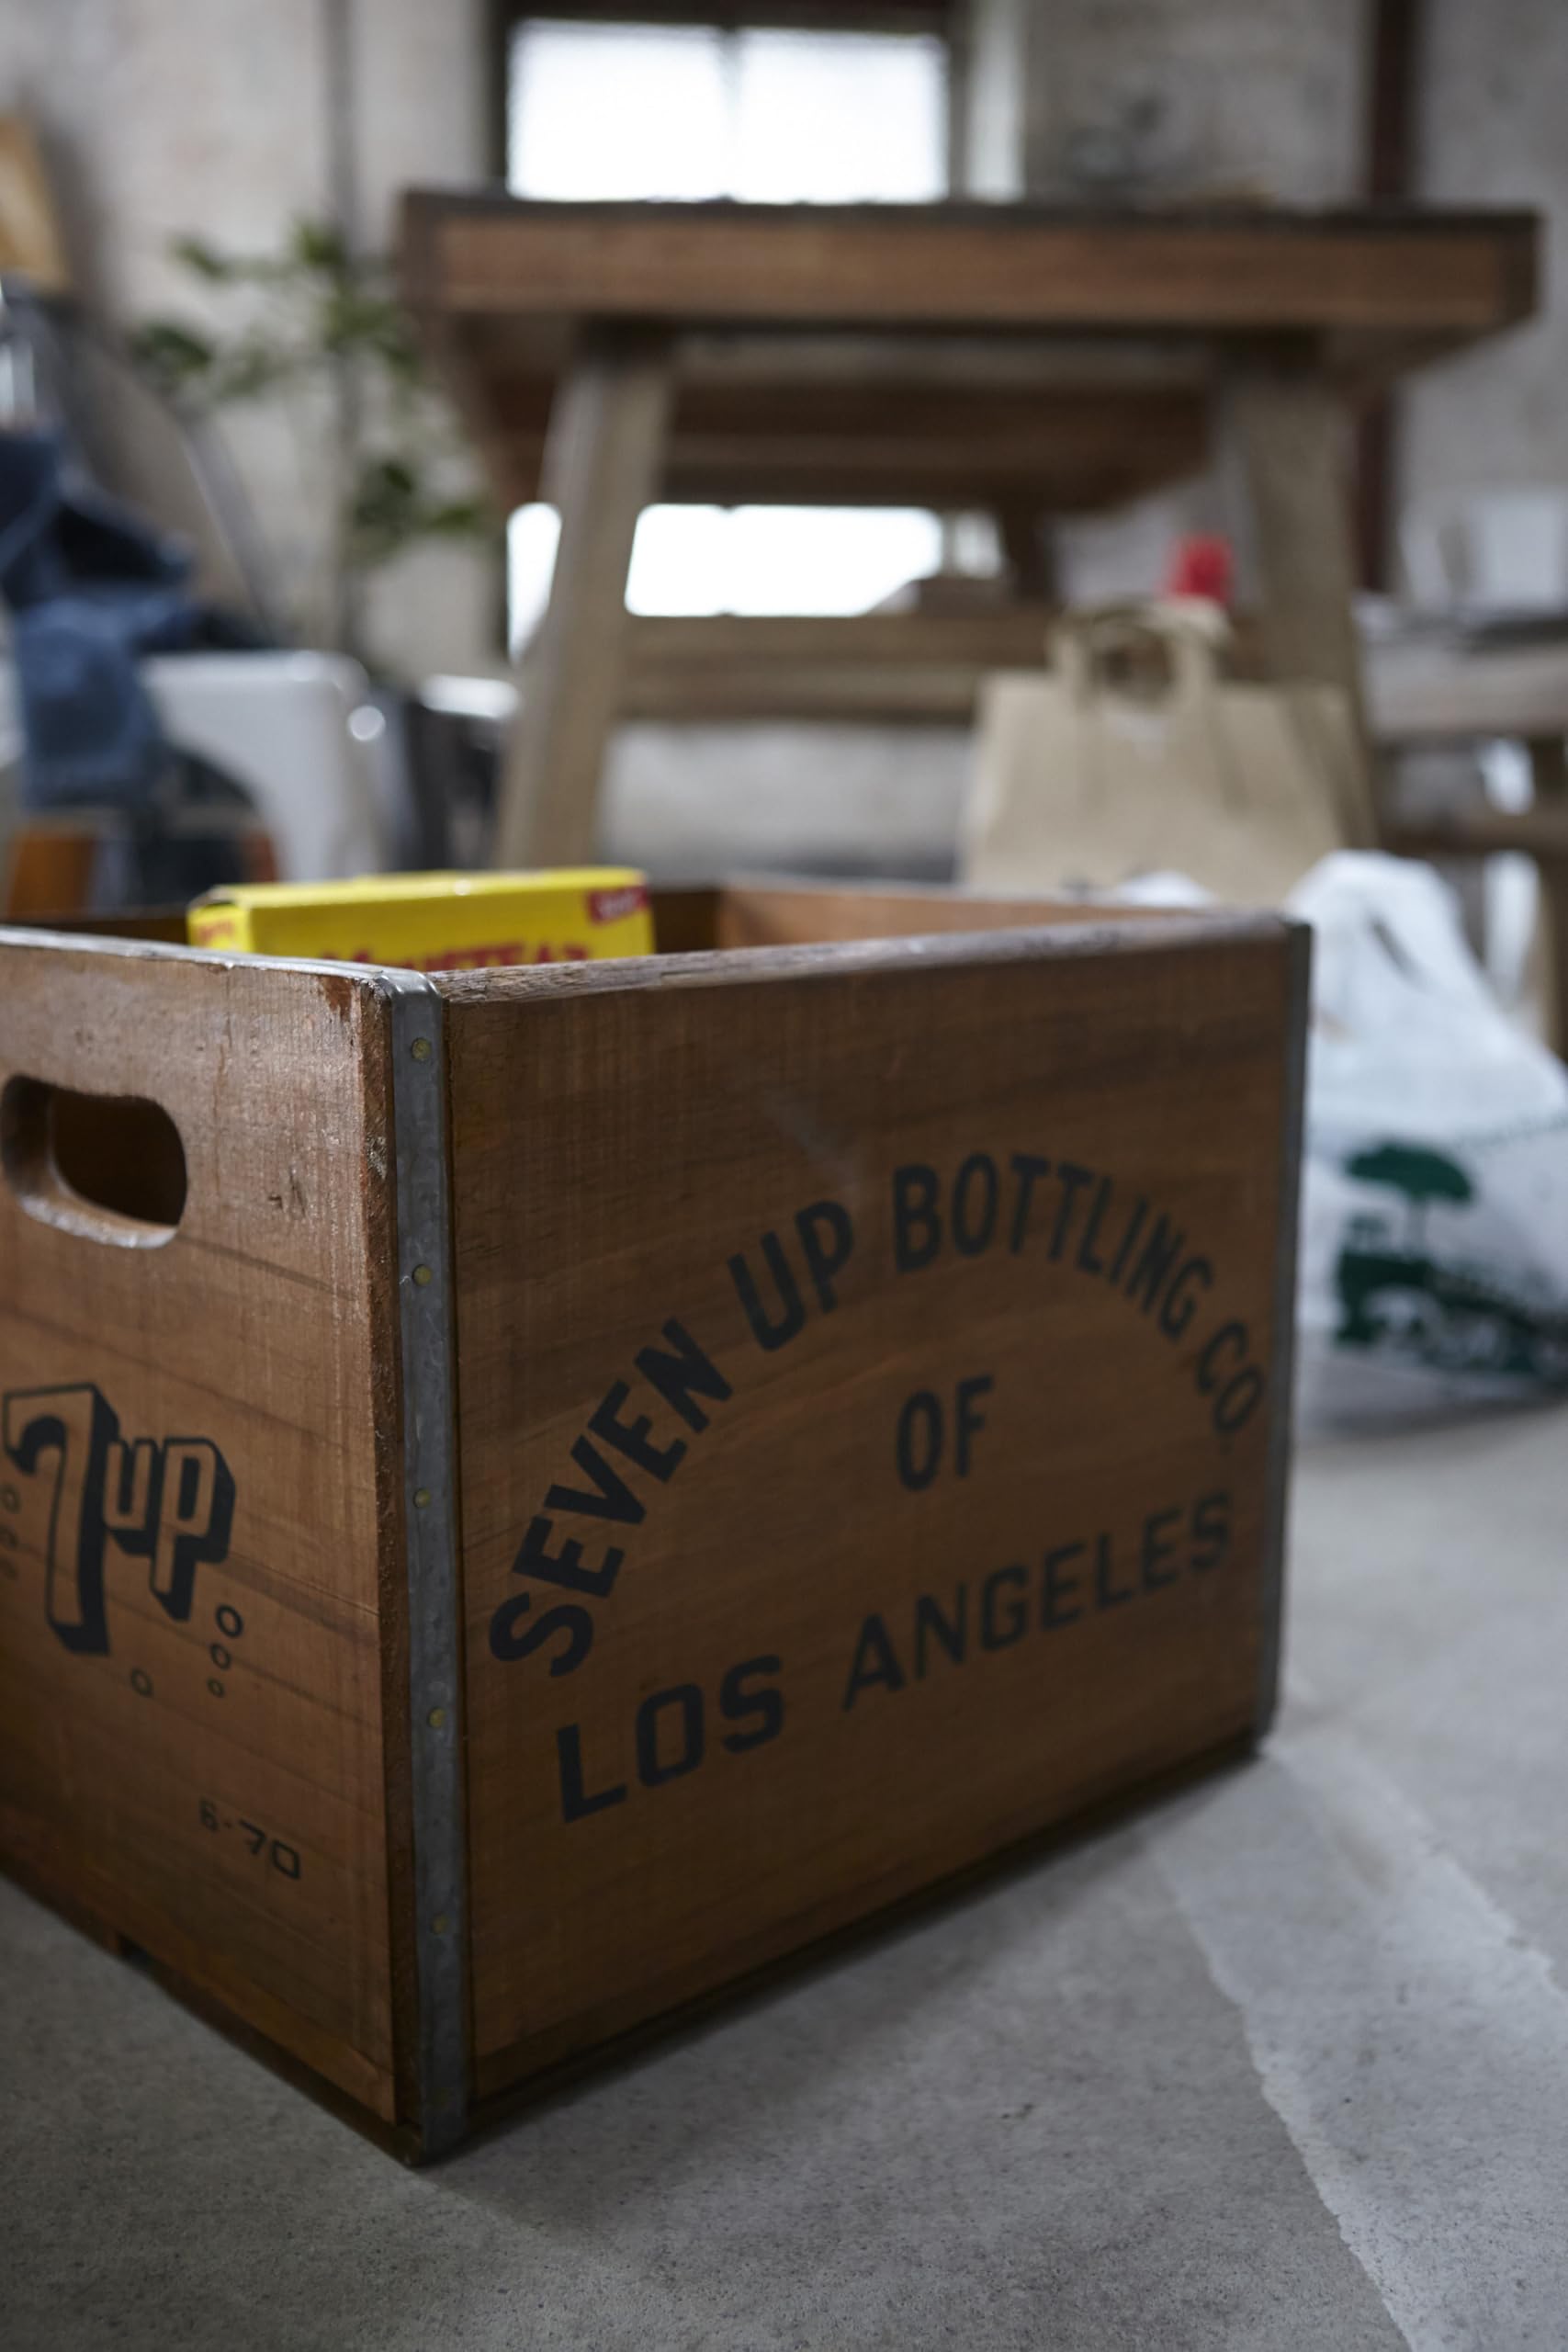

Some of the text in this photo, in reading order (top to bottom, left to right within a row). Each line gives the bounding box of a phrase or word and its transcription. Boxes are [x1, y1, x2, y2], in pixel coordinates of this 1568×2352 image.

[489, 1317, 733, 1678] SEVEN
[727, 1201, 854, 1352] UP
[892, 1152, 1214, 1341] BOTTLING
[896, 1375, 996, 1493] OF
[557, 1492, 1234, 1823] LOS ANGELES
